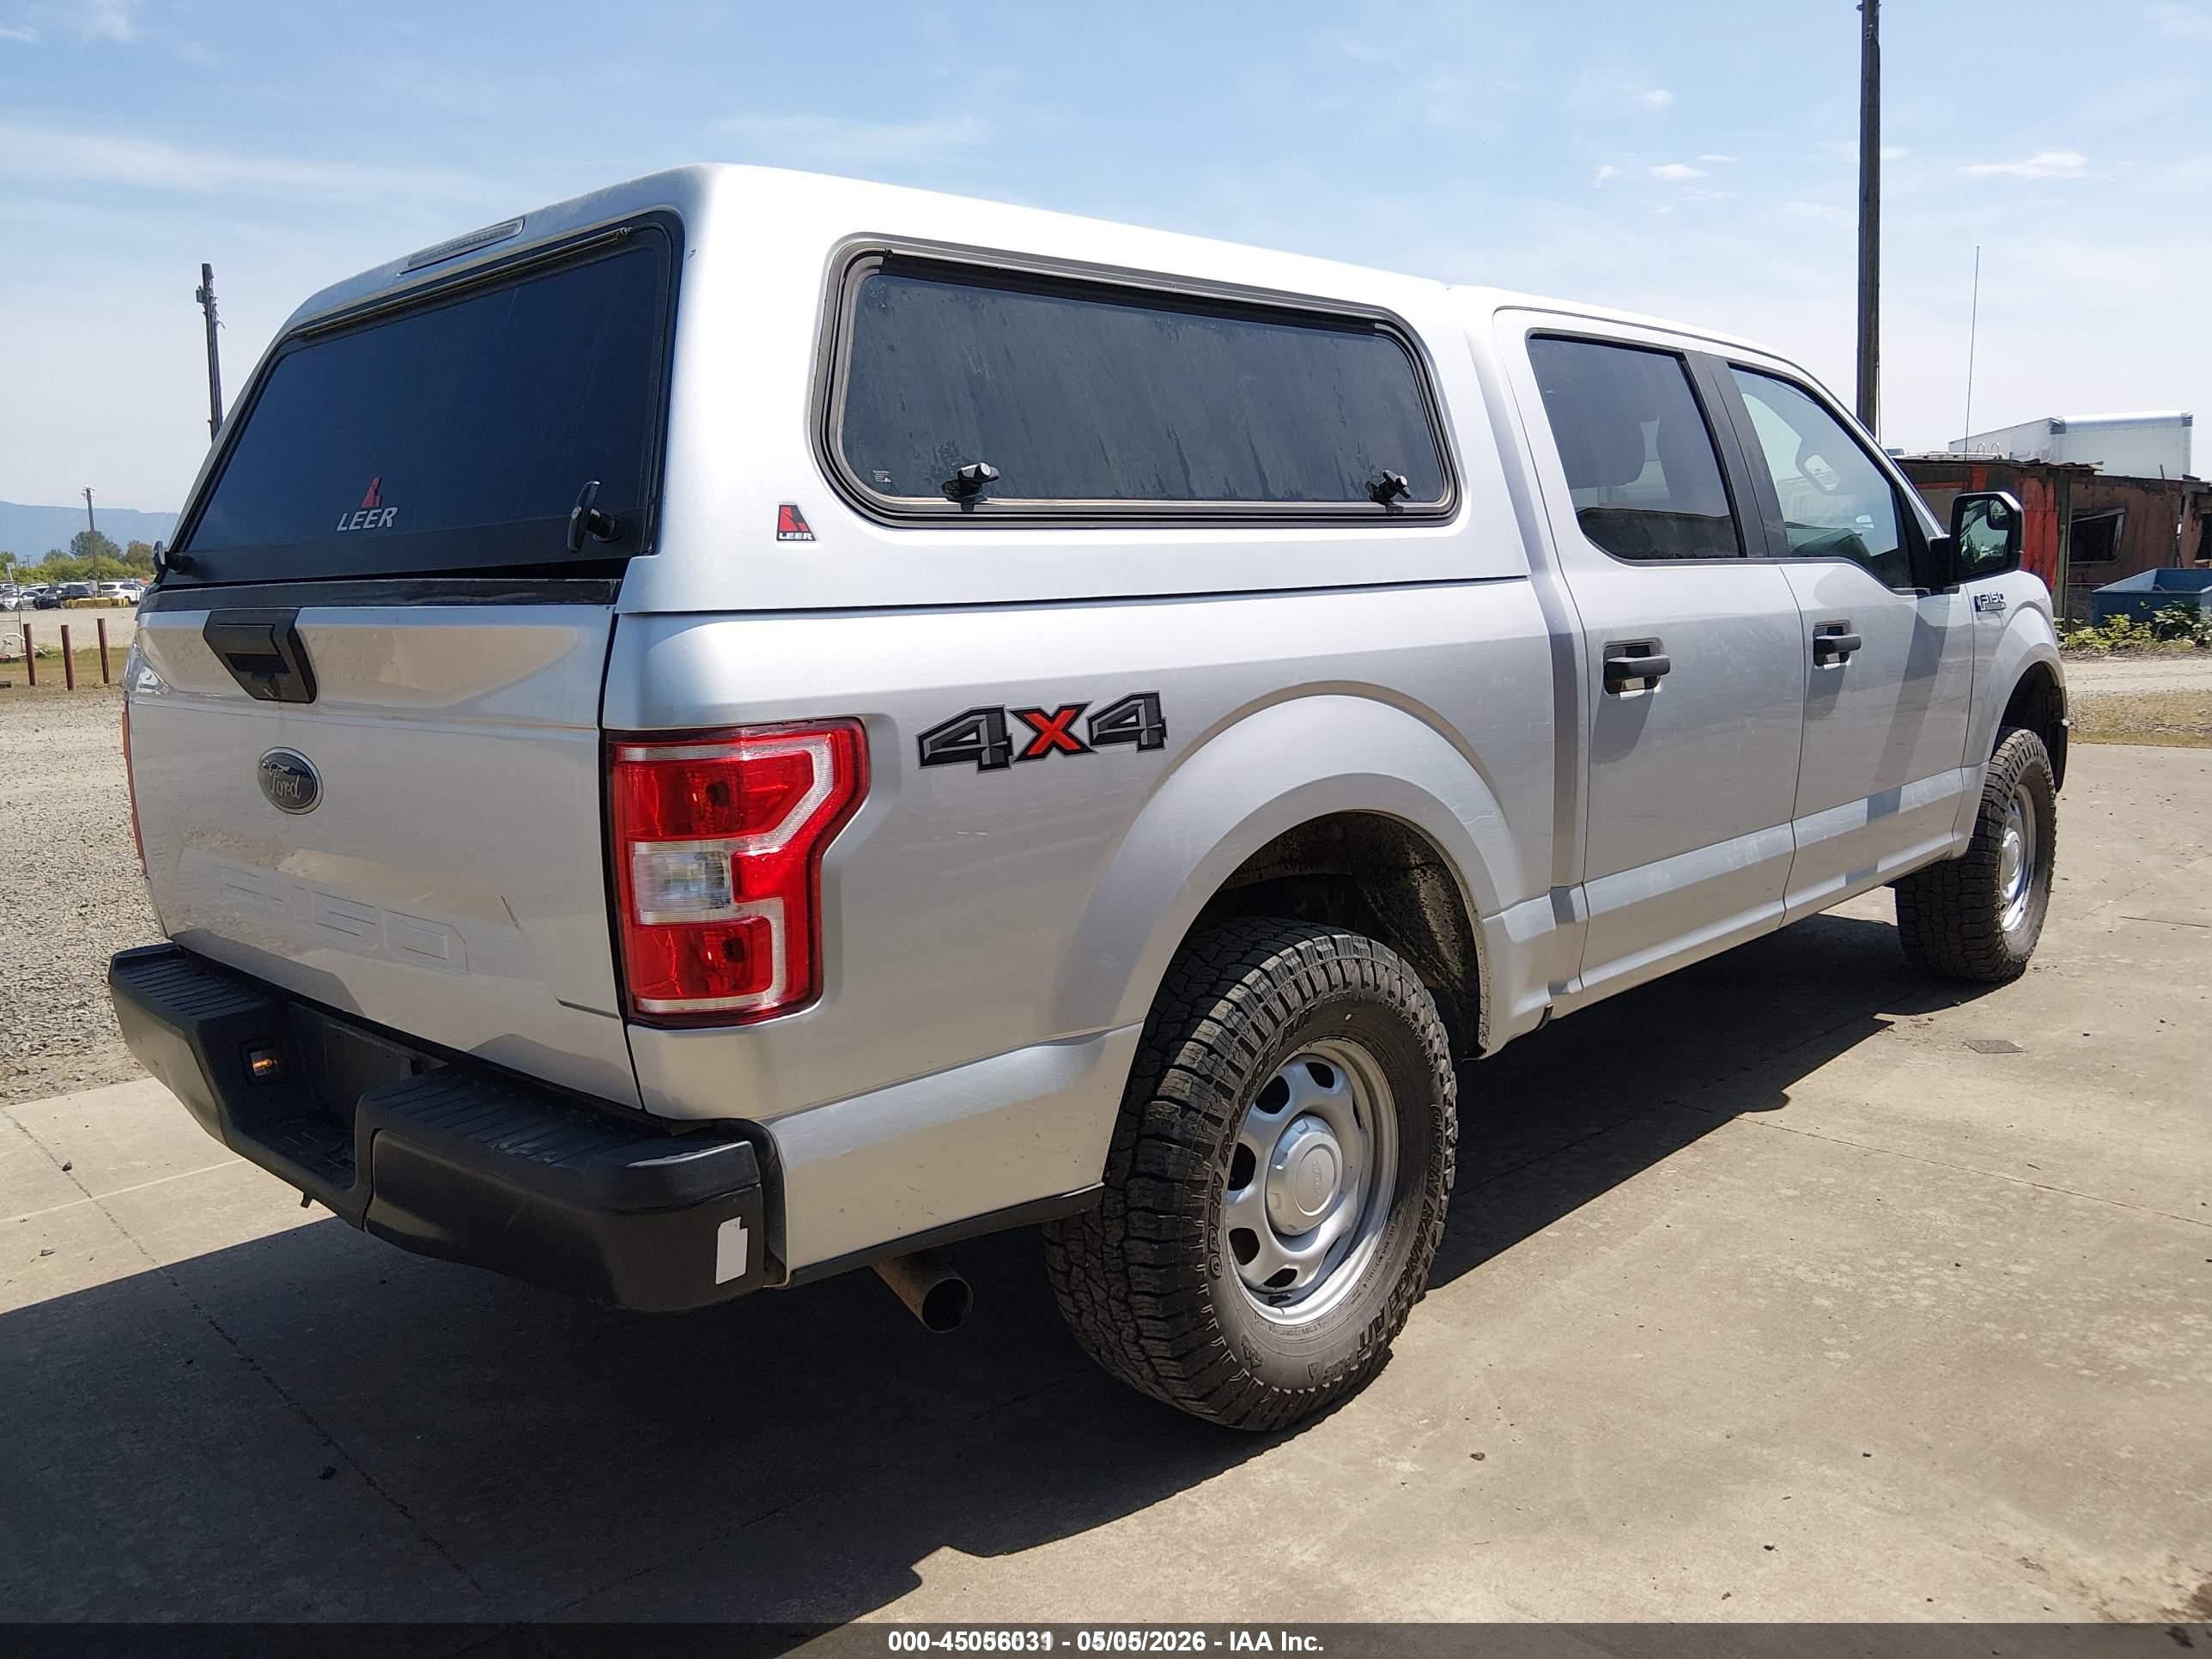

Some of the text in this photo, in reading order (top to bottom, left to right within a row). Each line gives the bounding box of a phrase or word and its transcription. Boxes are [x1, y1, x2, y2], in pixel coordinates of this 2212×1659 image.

[336, 507, 398, 532] LEER
[268, 762, 303, 799] Ford
[1208, 1170, 1224, 1280] OPEN
[1387, 1199, 1434, 1316] RANGE
